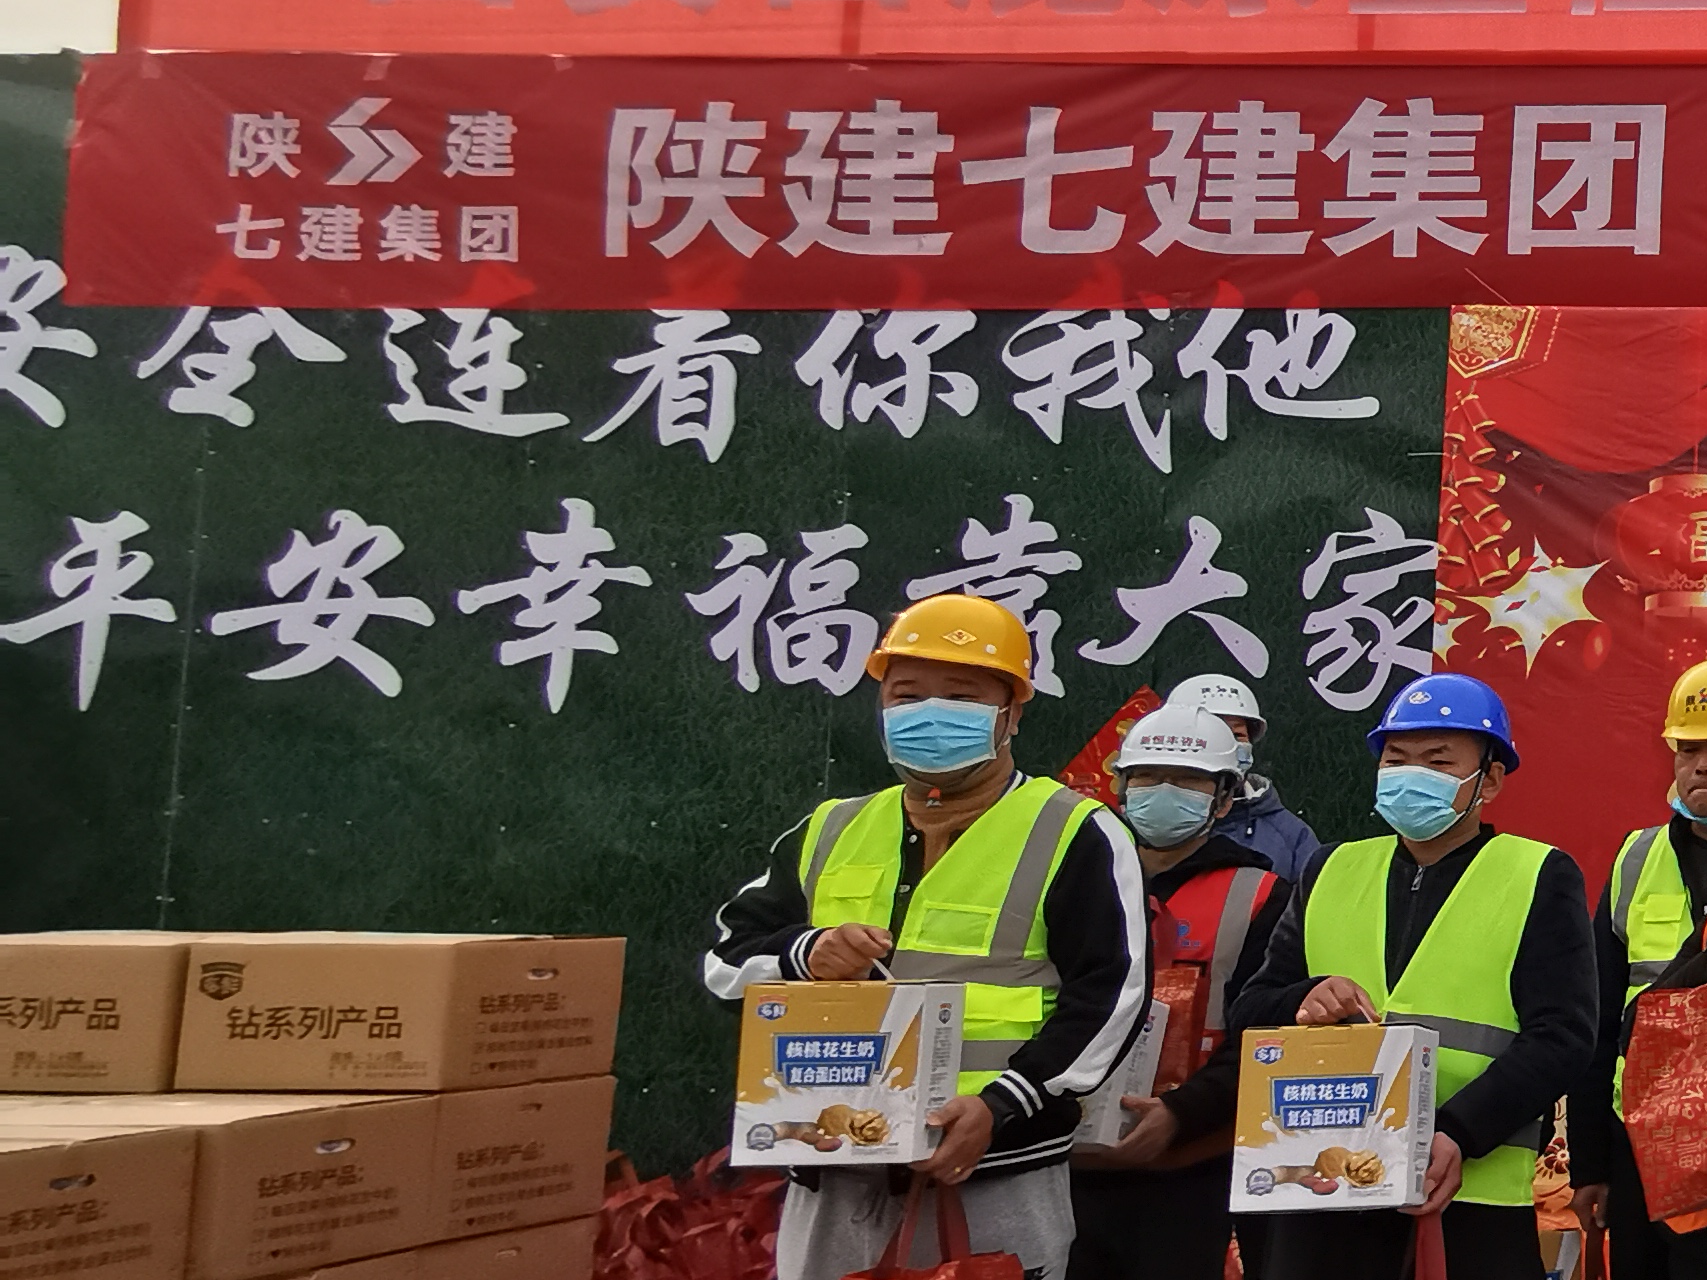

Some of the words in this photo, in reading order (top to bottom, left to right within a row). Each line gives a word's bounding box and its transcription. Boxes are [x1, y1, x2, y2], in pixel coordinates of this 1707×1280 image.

[228, 111, 302, 178] 陕
[444, 111, 519, 179] 建
[604, 97, 1667, 259] 陕建七建集团
[216, 204, 519, 262] 七建集团
[0, 493, 1439, 715] 平安幸福靠大家
[227, 1004, 402, 1040] 钻系列产品
[785, 1040, 876, 1059] 核桃花生奶
[1283, 1083, 1369, 1102] 核桃花生奶
